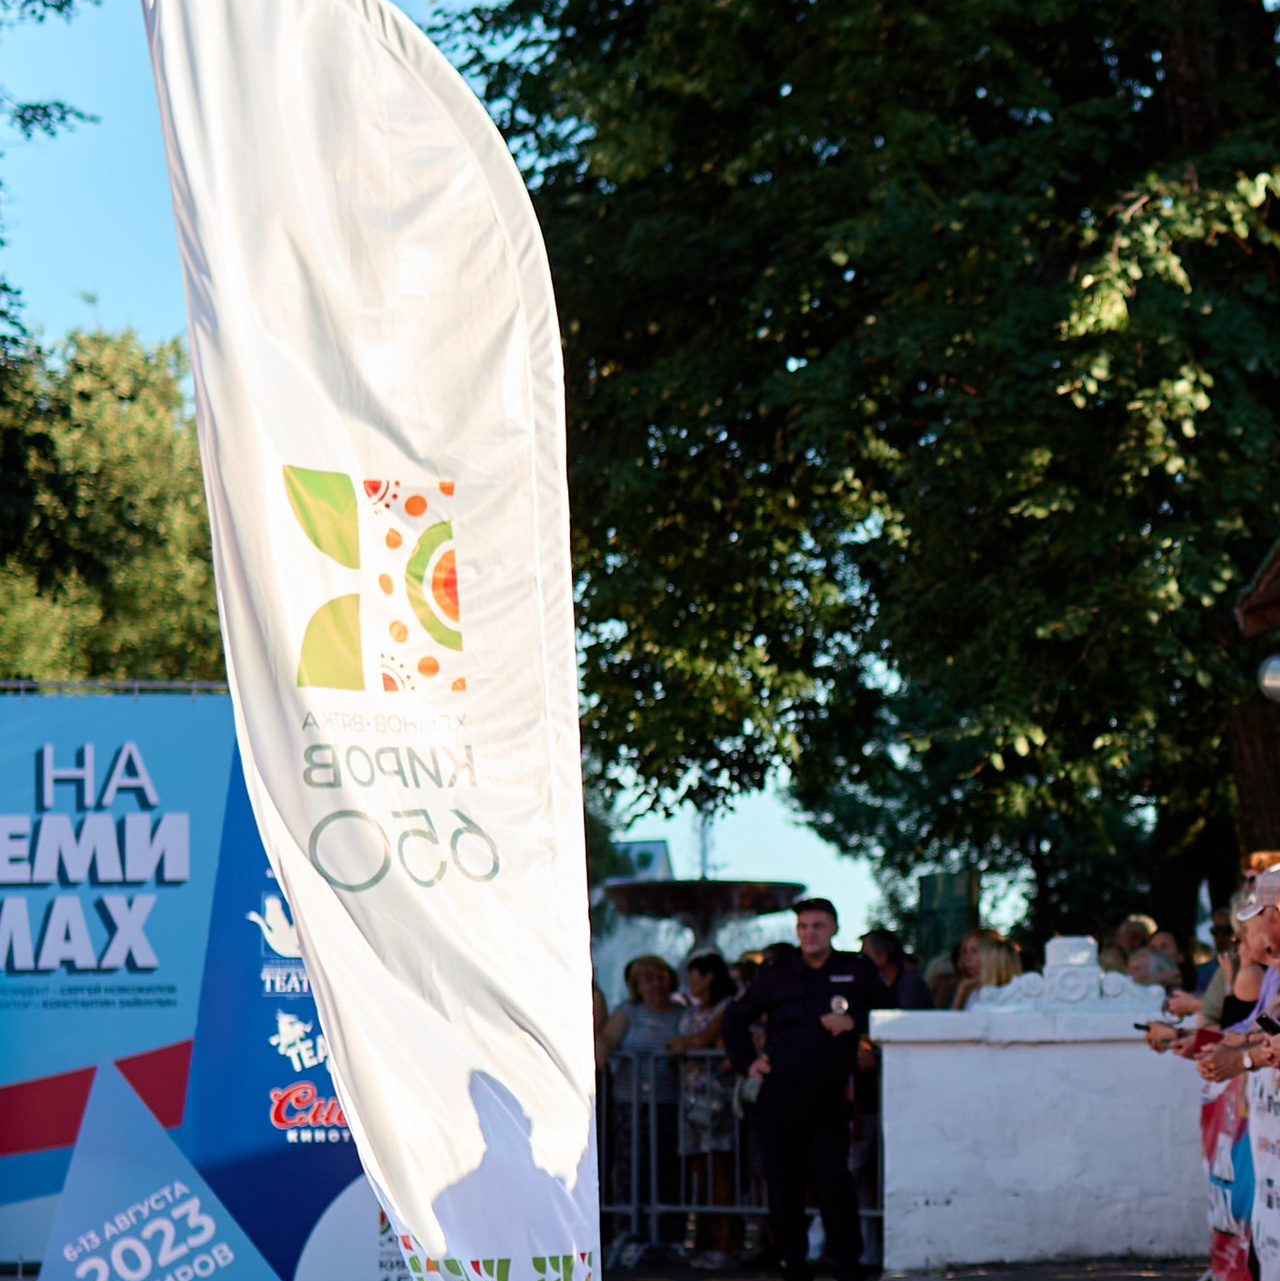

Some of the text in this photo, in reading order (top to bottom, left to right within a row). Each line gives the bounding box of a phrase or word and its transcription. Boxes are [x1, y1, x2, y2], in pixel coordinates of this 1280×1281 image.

[36, 741, 160, 811] НА
[63, 1180, 191, 1262] 6-13 АВГУСТА
